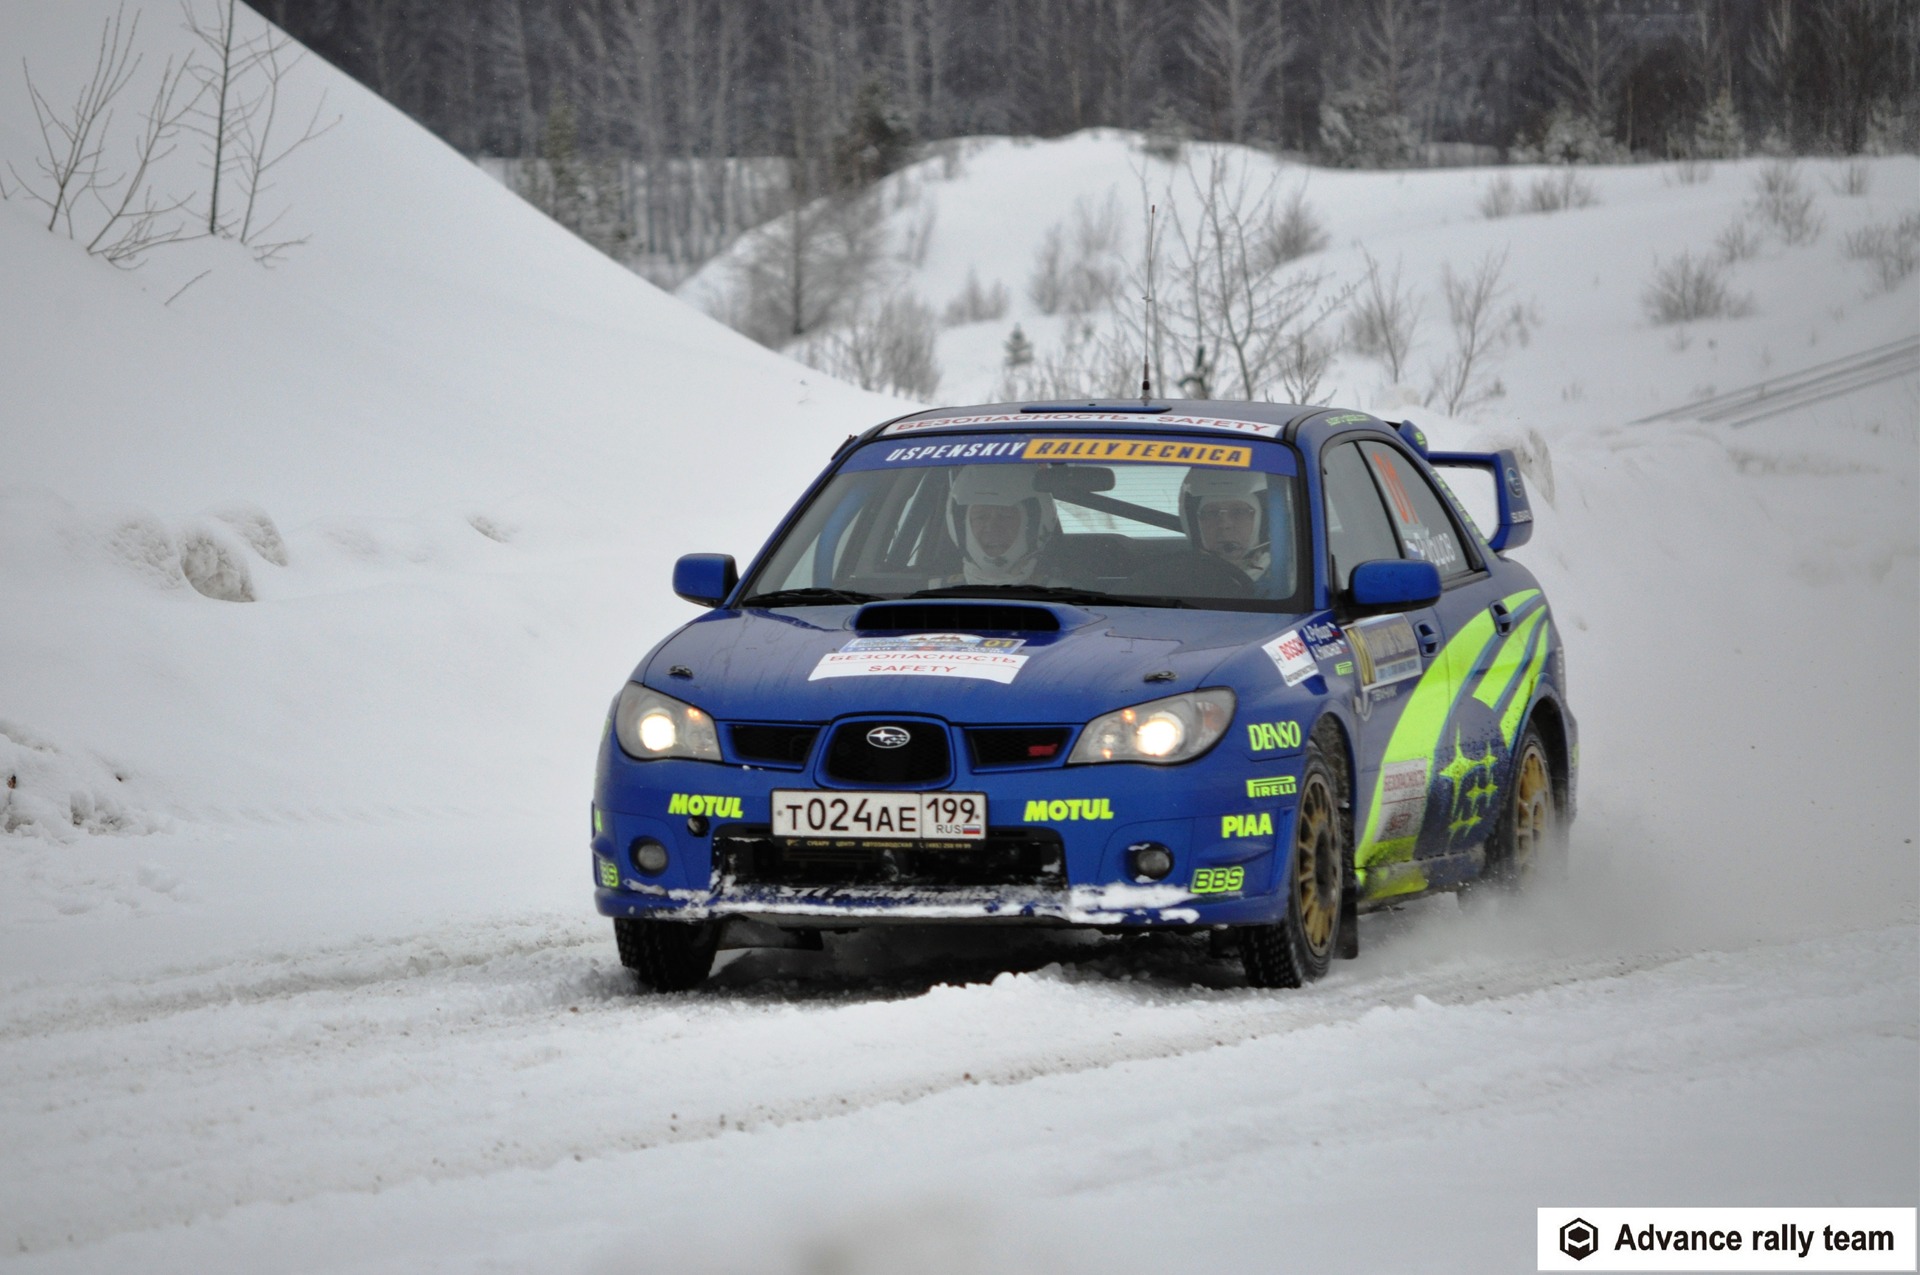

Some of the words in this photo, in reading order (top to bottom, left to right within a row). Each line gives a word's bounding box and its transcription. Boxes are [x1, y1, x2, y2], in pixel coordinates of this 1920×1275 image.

[896, 413, 1128, 431] БЕЗОПАСНОСТЬ
[1157, 416, 1270, 432] SAFETY
[886, 442, 1027, 462] USPENSKIY
[1036, 441, 1120, 457] RALLY
[1127, 443, 1243, 463] TECNICA
[983, 639, 1013, 648] 01
[829, 653, 1017, 664] БЕЗОПАСНОСТЬ
[868, 664, 958, 673] SAFETY
[1247, 720, 1302, 752] DENSO
[1246, 774, 1298, 799] PIRELLI
[667, 793, 744, 819] MOTUL
[926, 797, 976, 824] 199
[1023, 798, 1115, 822] MOTUL
[936, 823, 962, 835] RUS
[1221, 812, 1274, 839] PIAA
[1190, 866, 1245, 894] BBS
